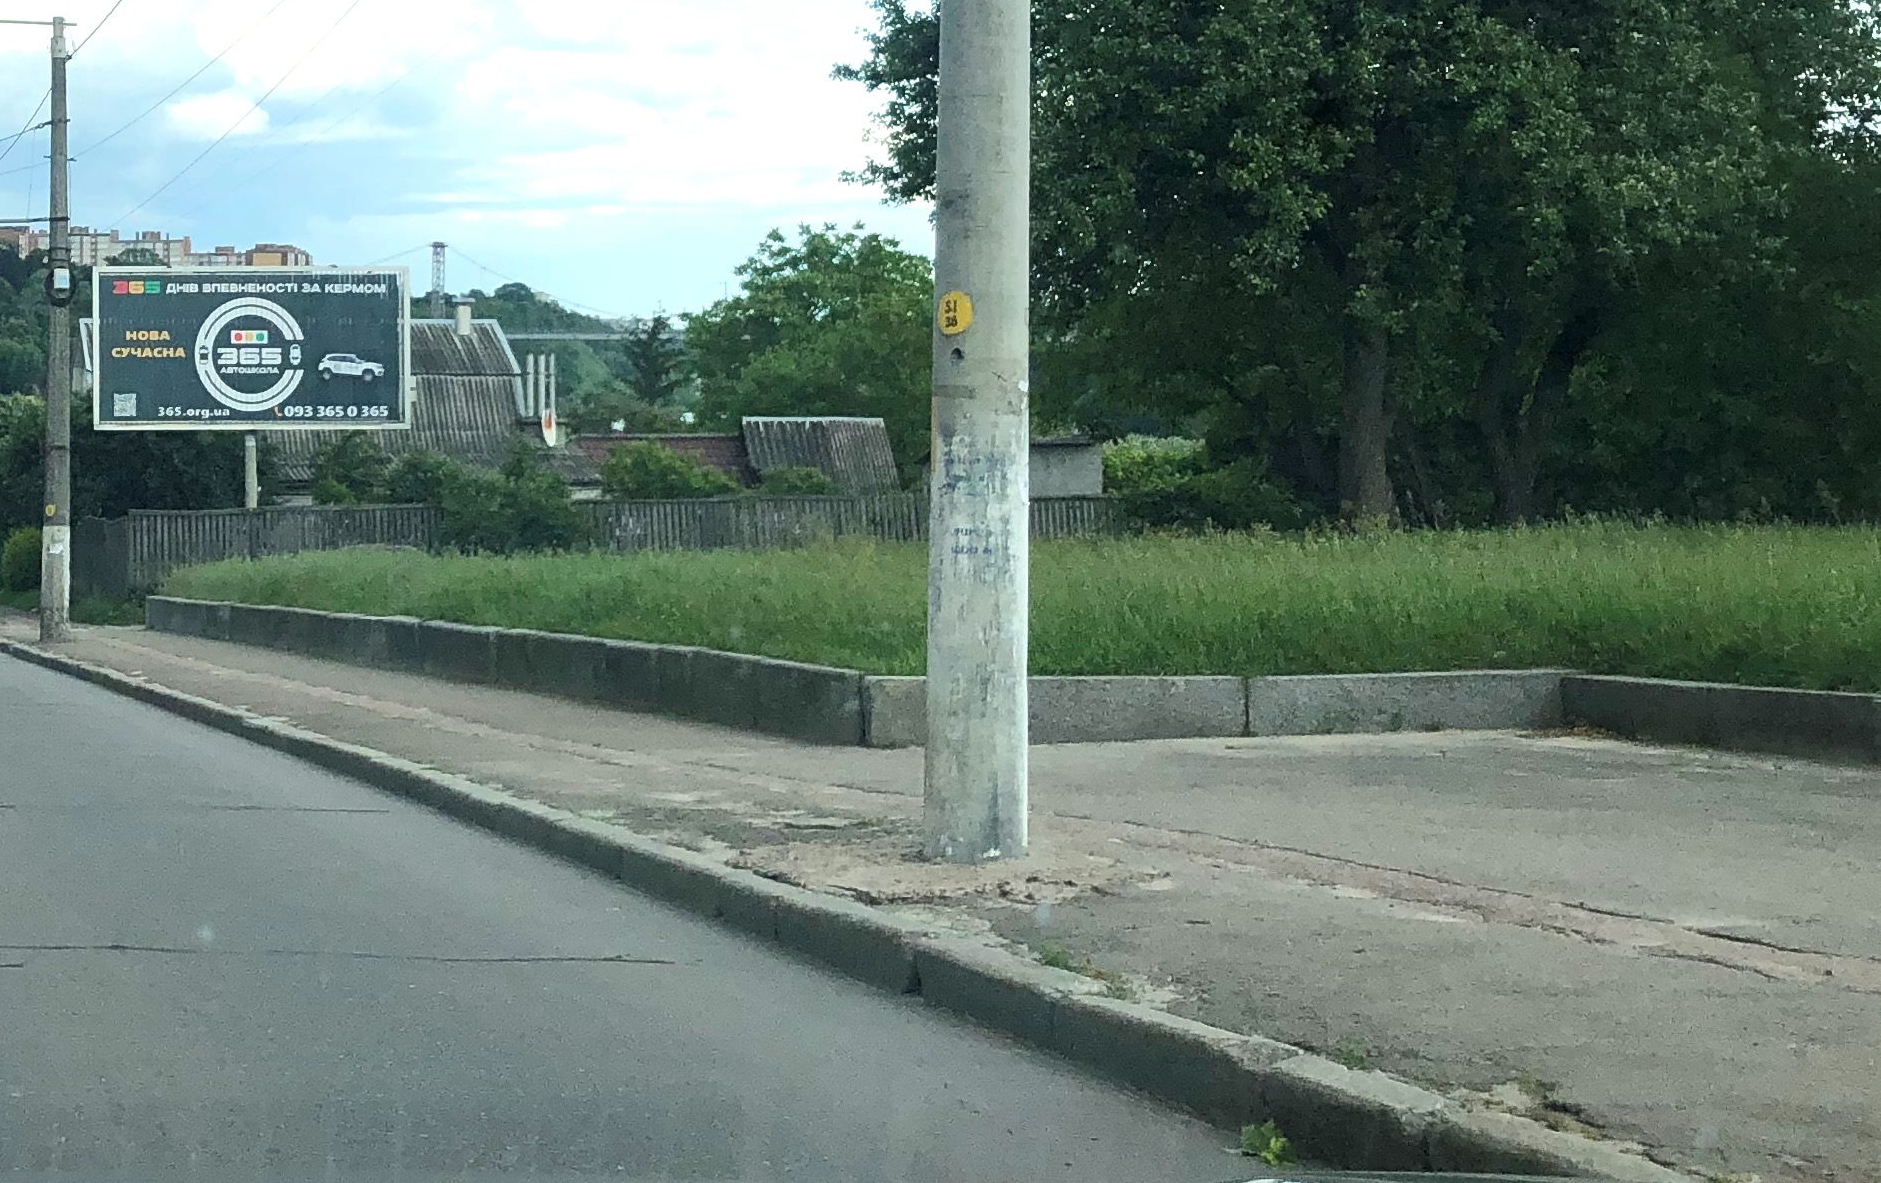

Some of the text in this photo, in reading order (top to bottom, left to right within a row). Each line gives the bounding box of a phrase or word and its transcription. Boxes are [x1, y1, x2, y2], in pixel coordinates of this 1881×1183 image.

[112, 280, 387, 295] 365 ДНІВ ВПЕВНЕНОСТІ ЗА КЕРМОМ
[125, 330, 171, 342] НОВА
[111, 347, 186, 359] СУЧАСНА
[216, 347, 282, 365] 365
[219, 366, 280, 374] АВТОШКОЛА
[157, 406, 230, 419] 365.org.ua
[284, 405, 389, 417] 093 365 0 365
